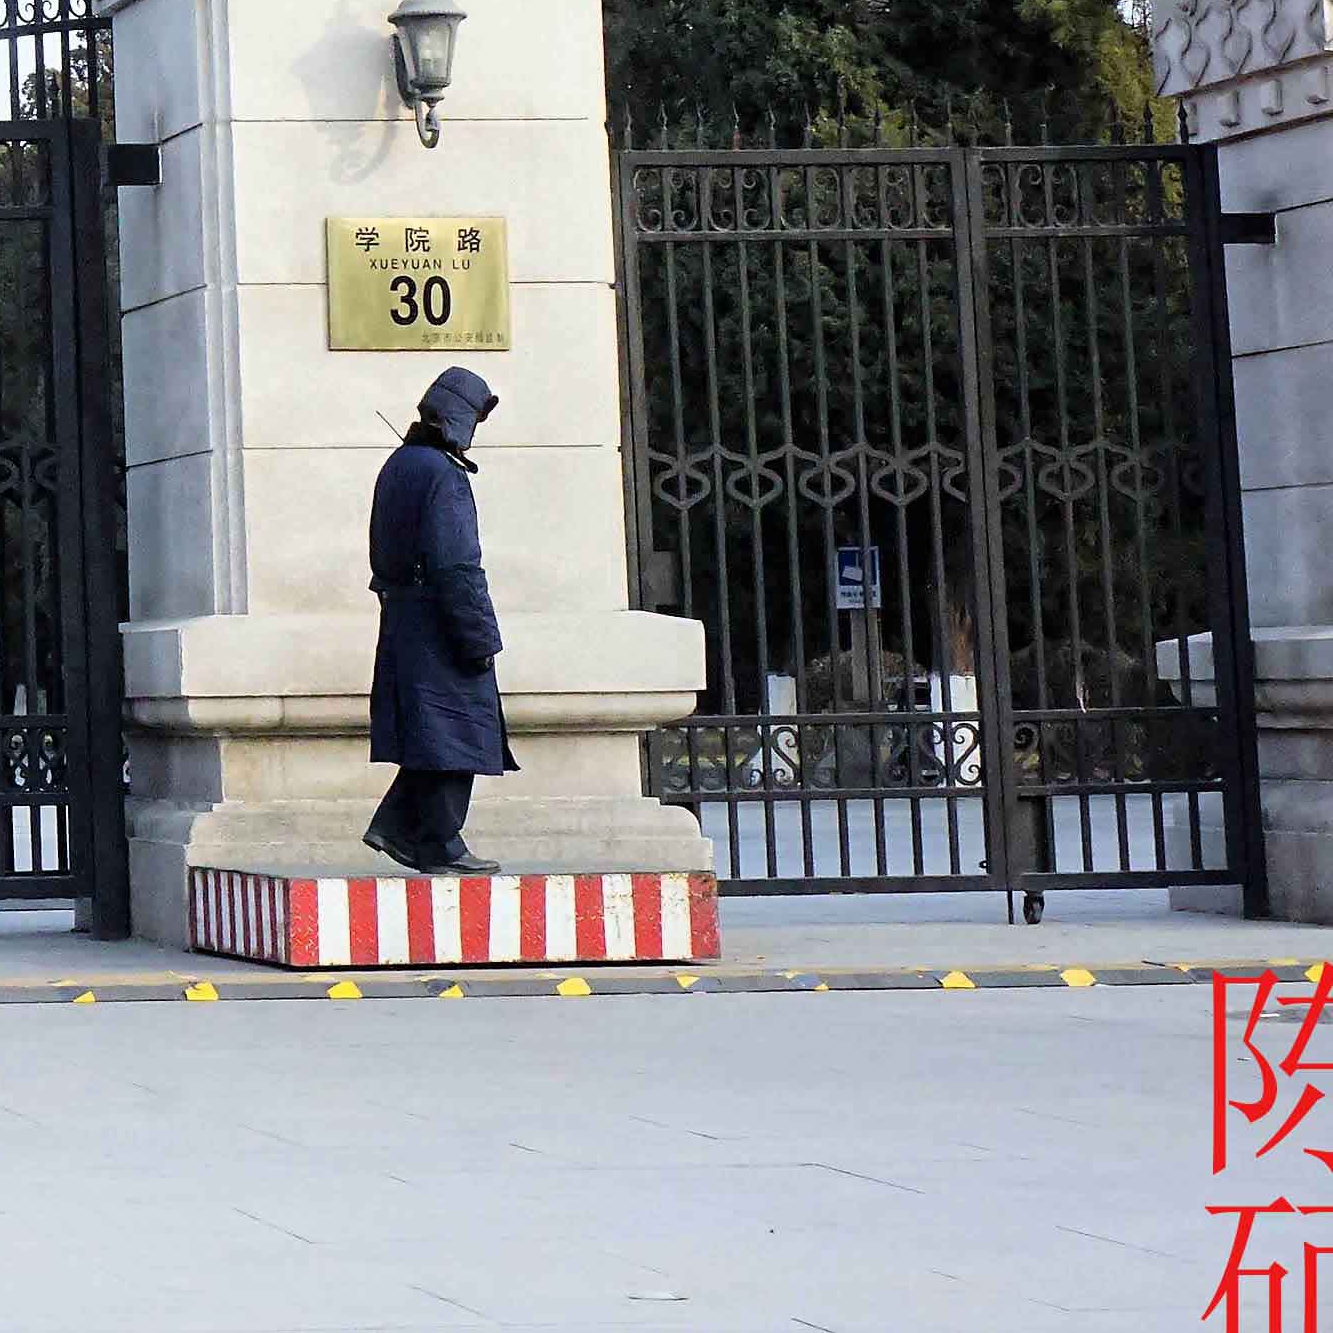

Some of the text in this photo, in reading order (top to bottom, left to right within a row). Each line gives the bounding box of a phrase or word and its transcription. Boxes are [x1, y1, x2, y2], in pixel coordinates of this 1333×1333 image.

[355, 226, 482, 253] 学院路
[369, 258, 471, 270] XUEYUAN LU
[389, 275, 452, 326] 30
